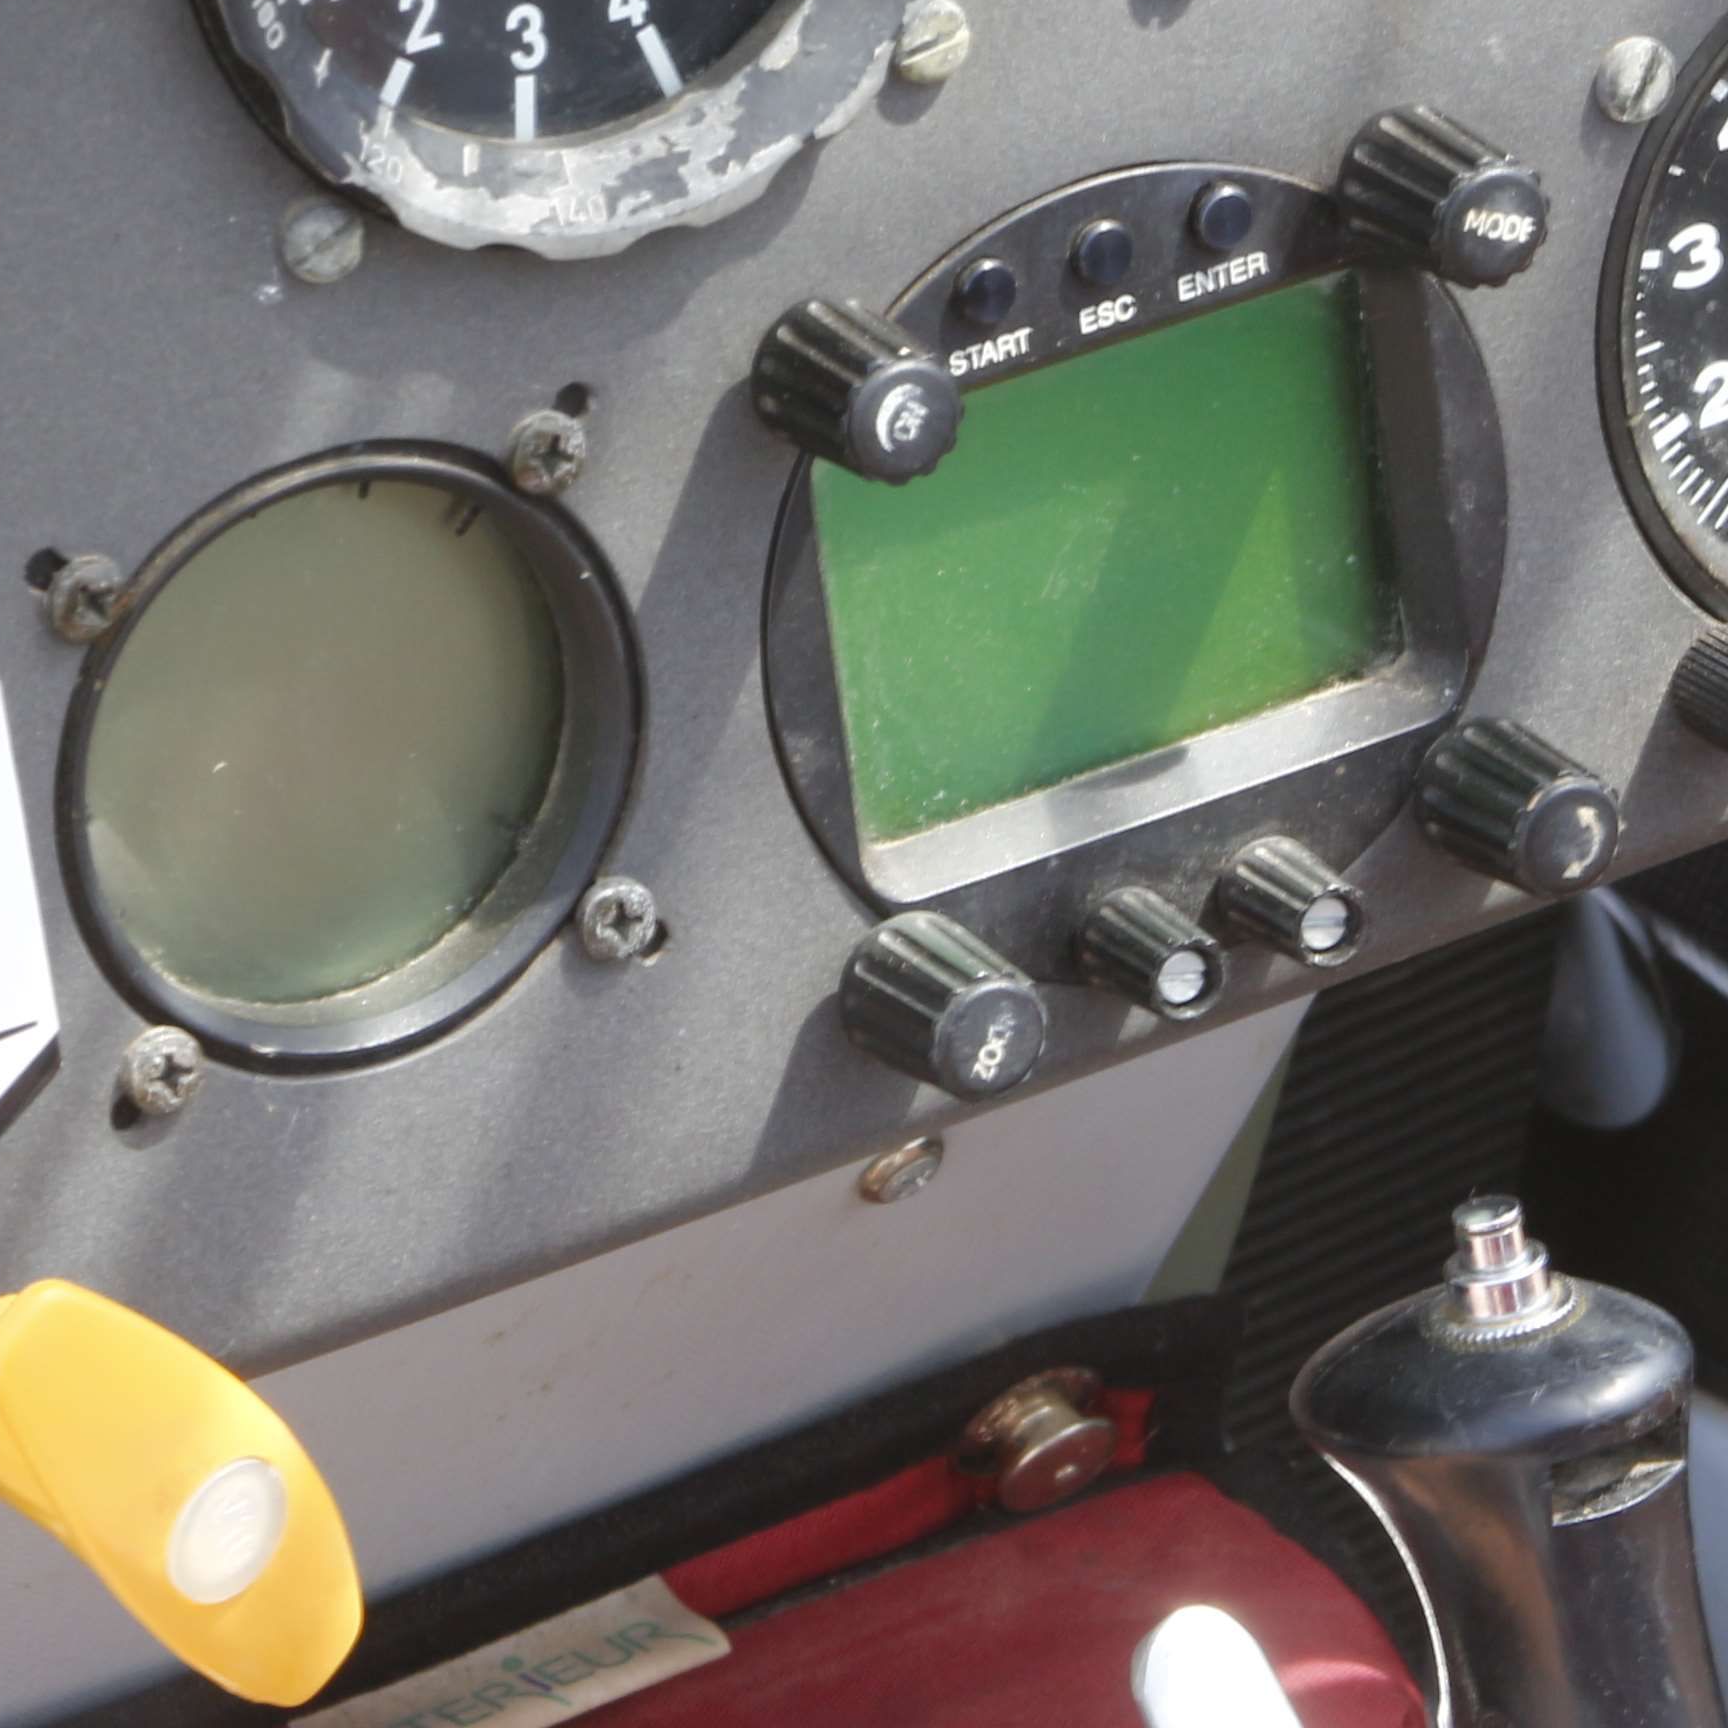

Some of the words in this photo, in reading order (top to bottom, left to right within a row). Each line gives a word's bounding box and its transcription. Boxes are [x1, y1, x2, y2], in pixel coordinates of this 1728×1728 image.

[506, 4, 548, 72] 3
[1177, 252, 1269, 302] ENTER
[1670, 222, 1724, 291] 3
[1078, 294, 1137, 334] ESC
[949, 327, 1033, 377] START
